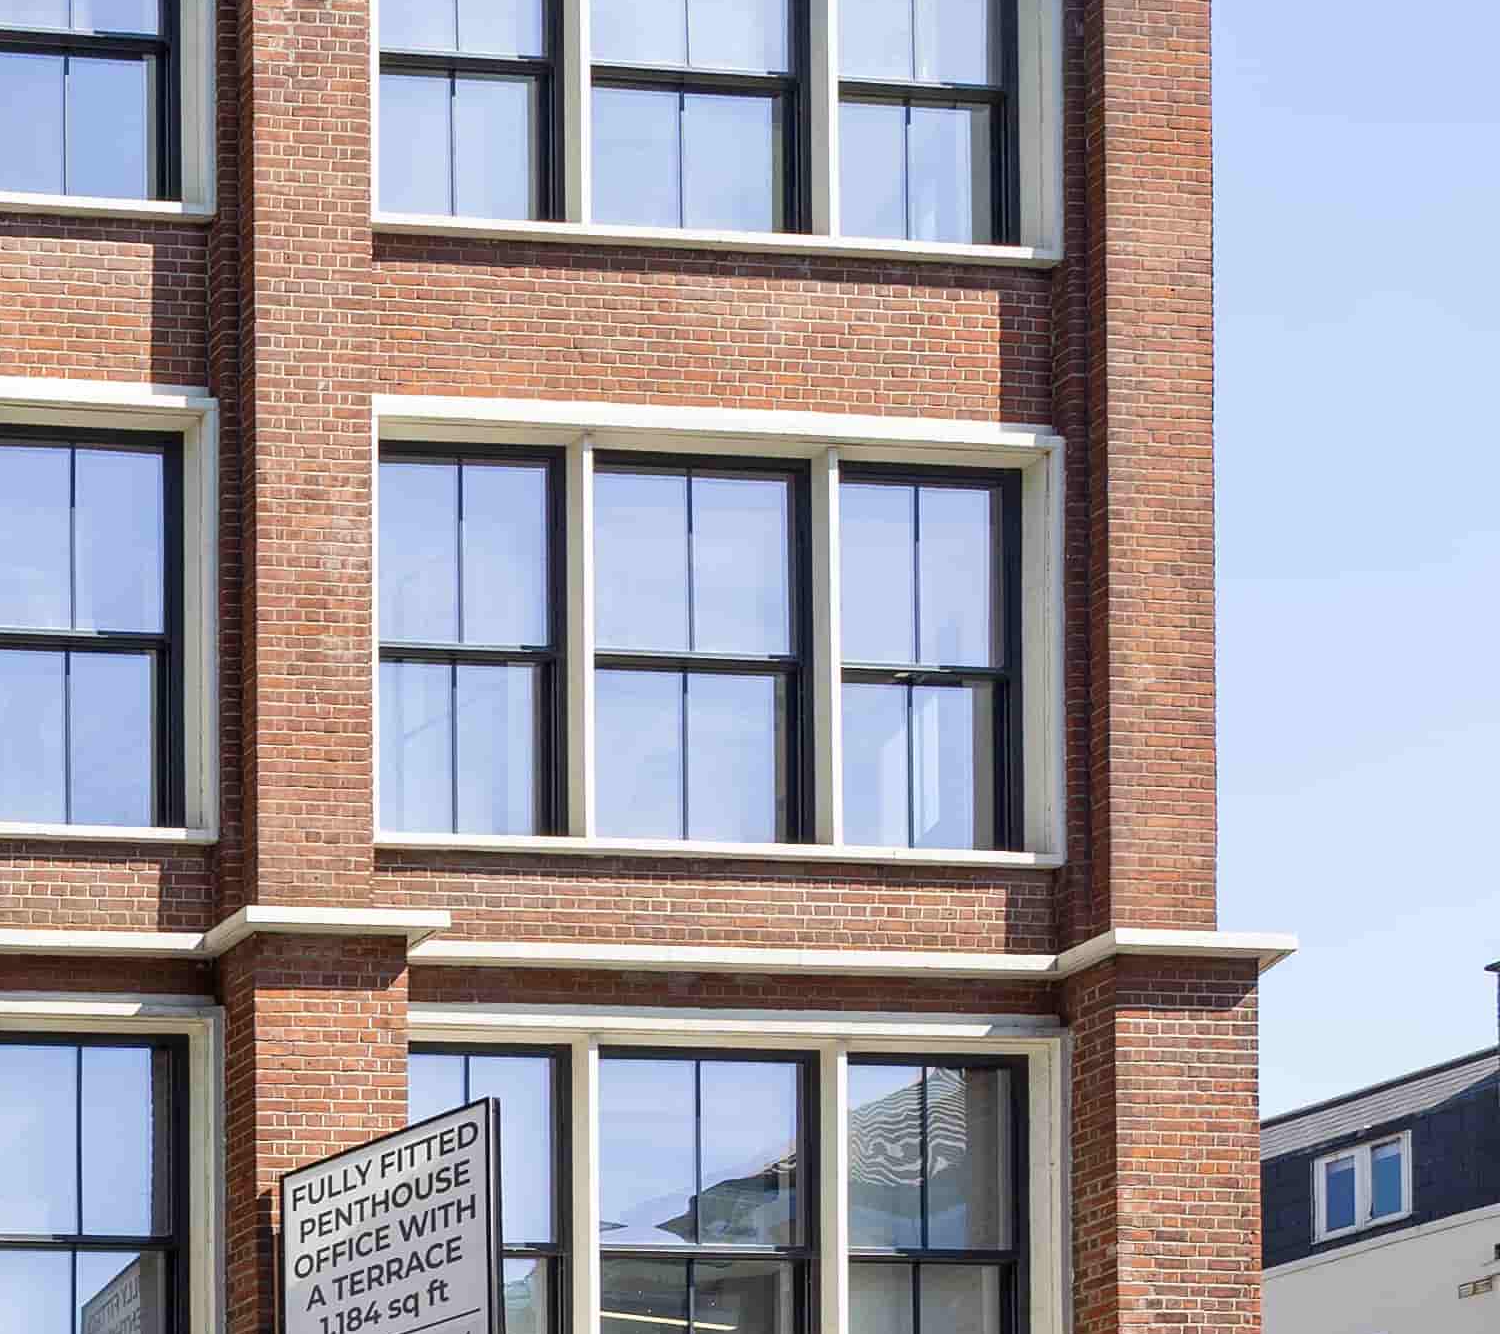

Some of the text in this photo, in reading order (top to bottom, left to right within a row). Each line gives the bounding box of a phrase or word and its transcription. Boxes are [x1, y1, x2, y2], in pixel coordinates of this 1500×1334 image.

[292, 1121, 479, 1212] FULLY FITTED
[300, 1159, 471, 1244] PENTHOUSE
[294, 1194, 477, 1279] OFFICE WITH
[306, 1235, 463, 1312] A TERRACE
[387, 1290, 420, 1321] sq
[427, 1278, 449, 1306] ft
